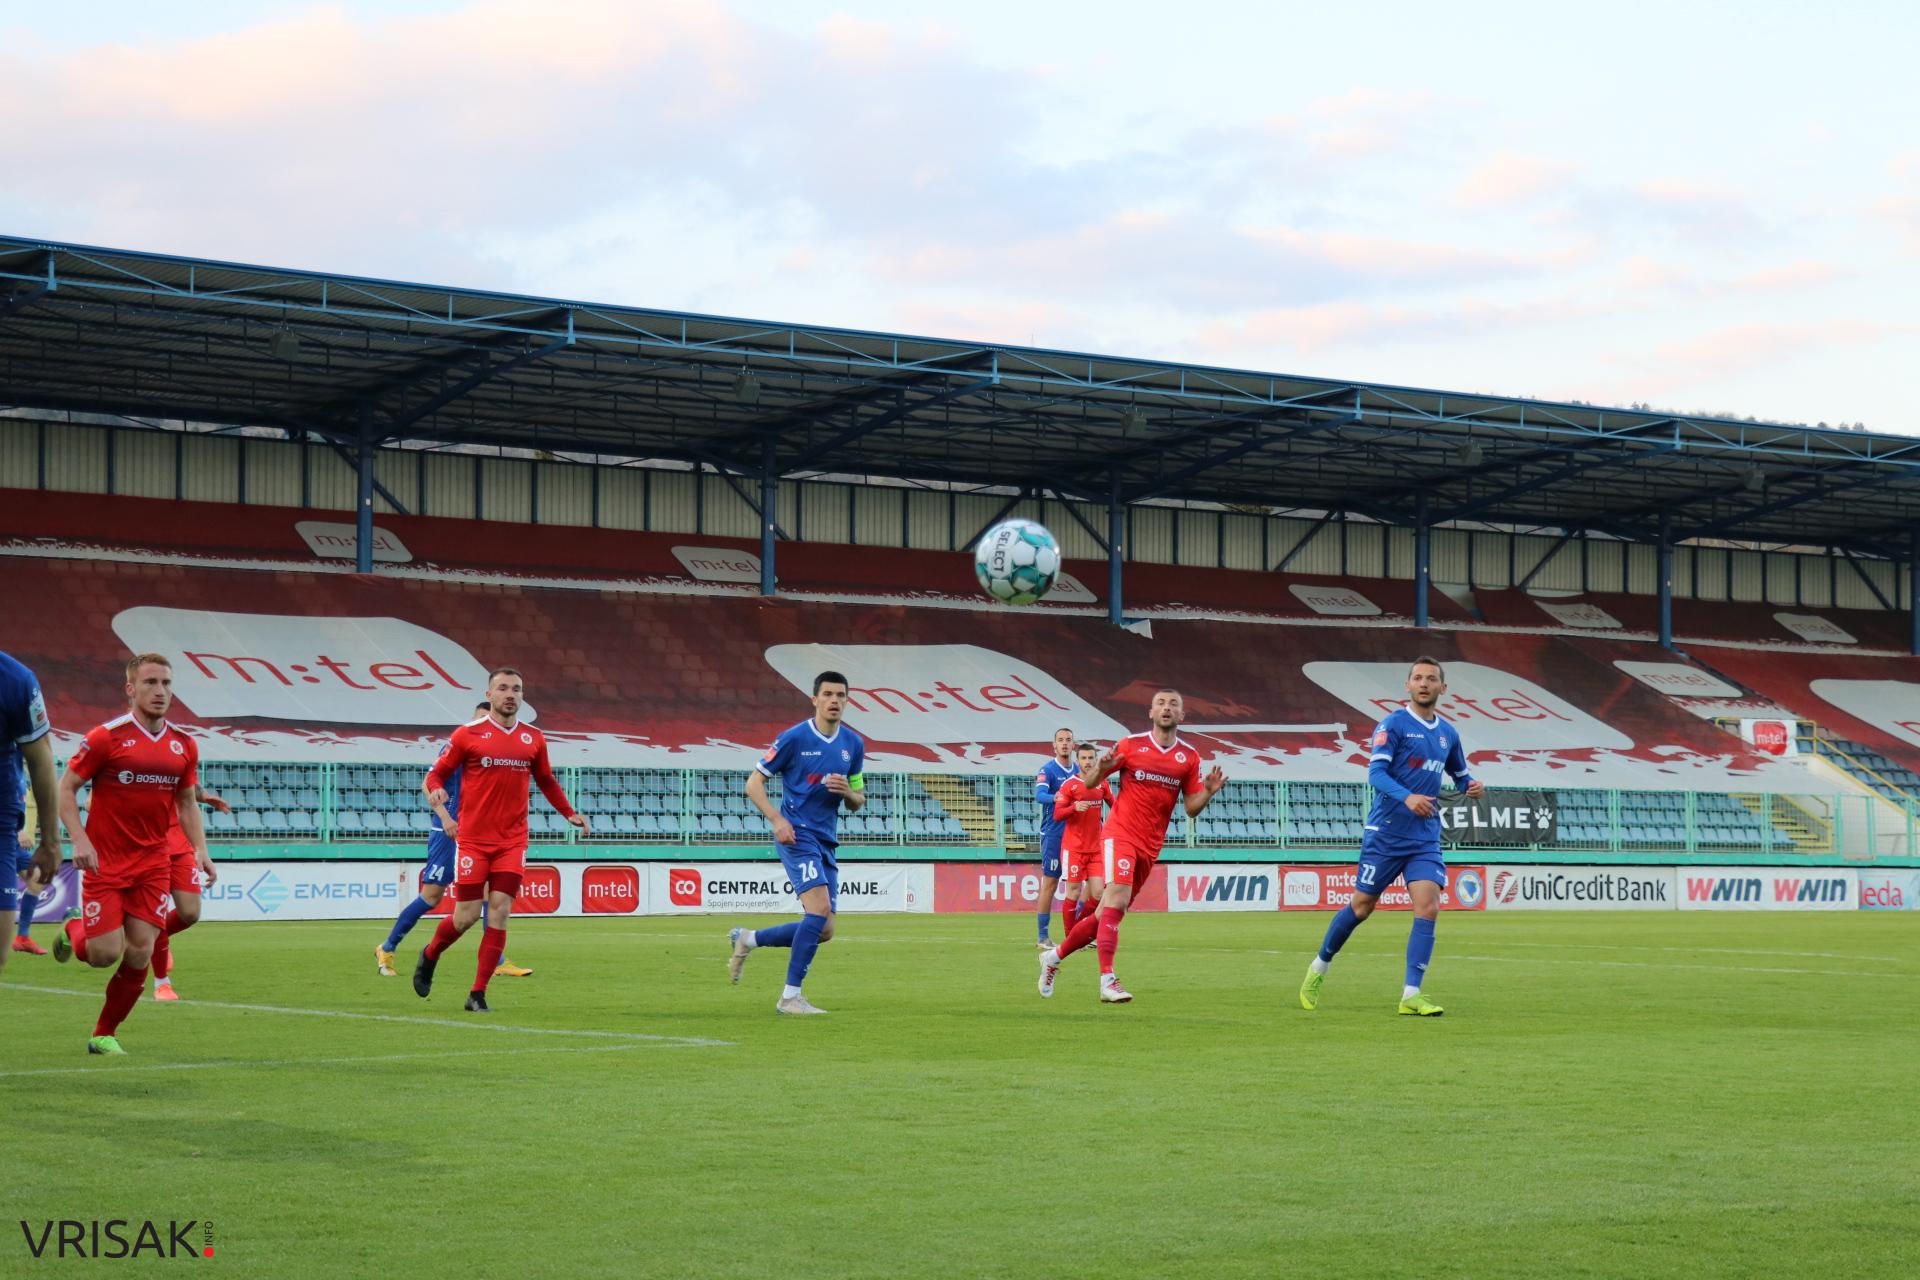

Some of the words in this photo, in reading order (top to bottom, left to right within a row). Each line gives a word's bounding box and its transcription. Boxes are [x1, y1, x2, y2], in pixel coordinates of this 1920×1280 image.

[992, 530, 1011, 573] SELECT
[688, 559, 760, 573] m:tel
[1306, 595, 1366, 607] m:tel
[183, 650, 473, 691] m:tel
[847, 674, 1071, 713] m:tel
[1756, 731, 1785, 745] m:tel
[428, 864, 445, 881] 24
[798, 860, 818, 882] 26
[1050, 859, 1059, 871] 19
[1326, 871, 1357, 887] m:te
[1360, 863, 1377, 885] 22
[295, 883, 397, 898] EMERUS
[588, 879, 633, 898] m:tel
[707, 881, 779, 894] CENTRAL
[1288, 882, 1315, 894] m:tel
[707, 900, 734, 908] Spojeni
[735, 900, 780, 909] povjerenjem
